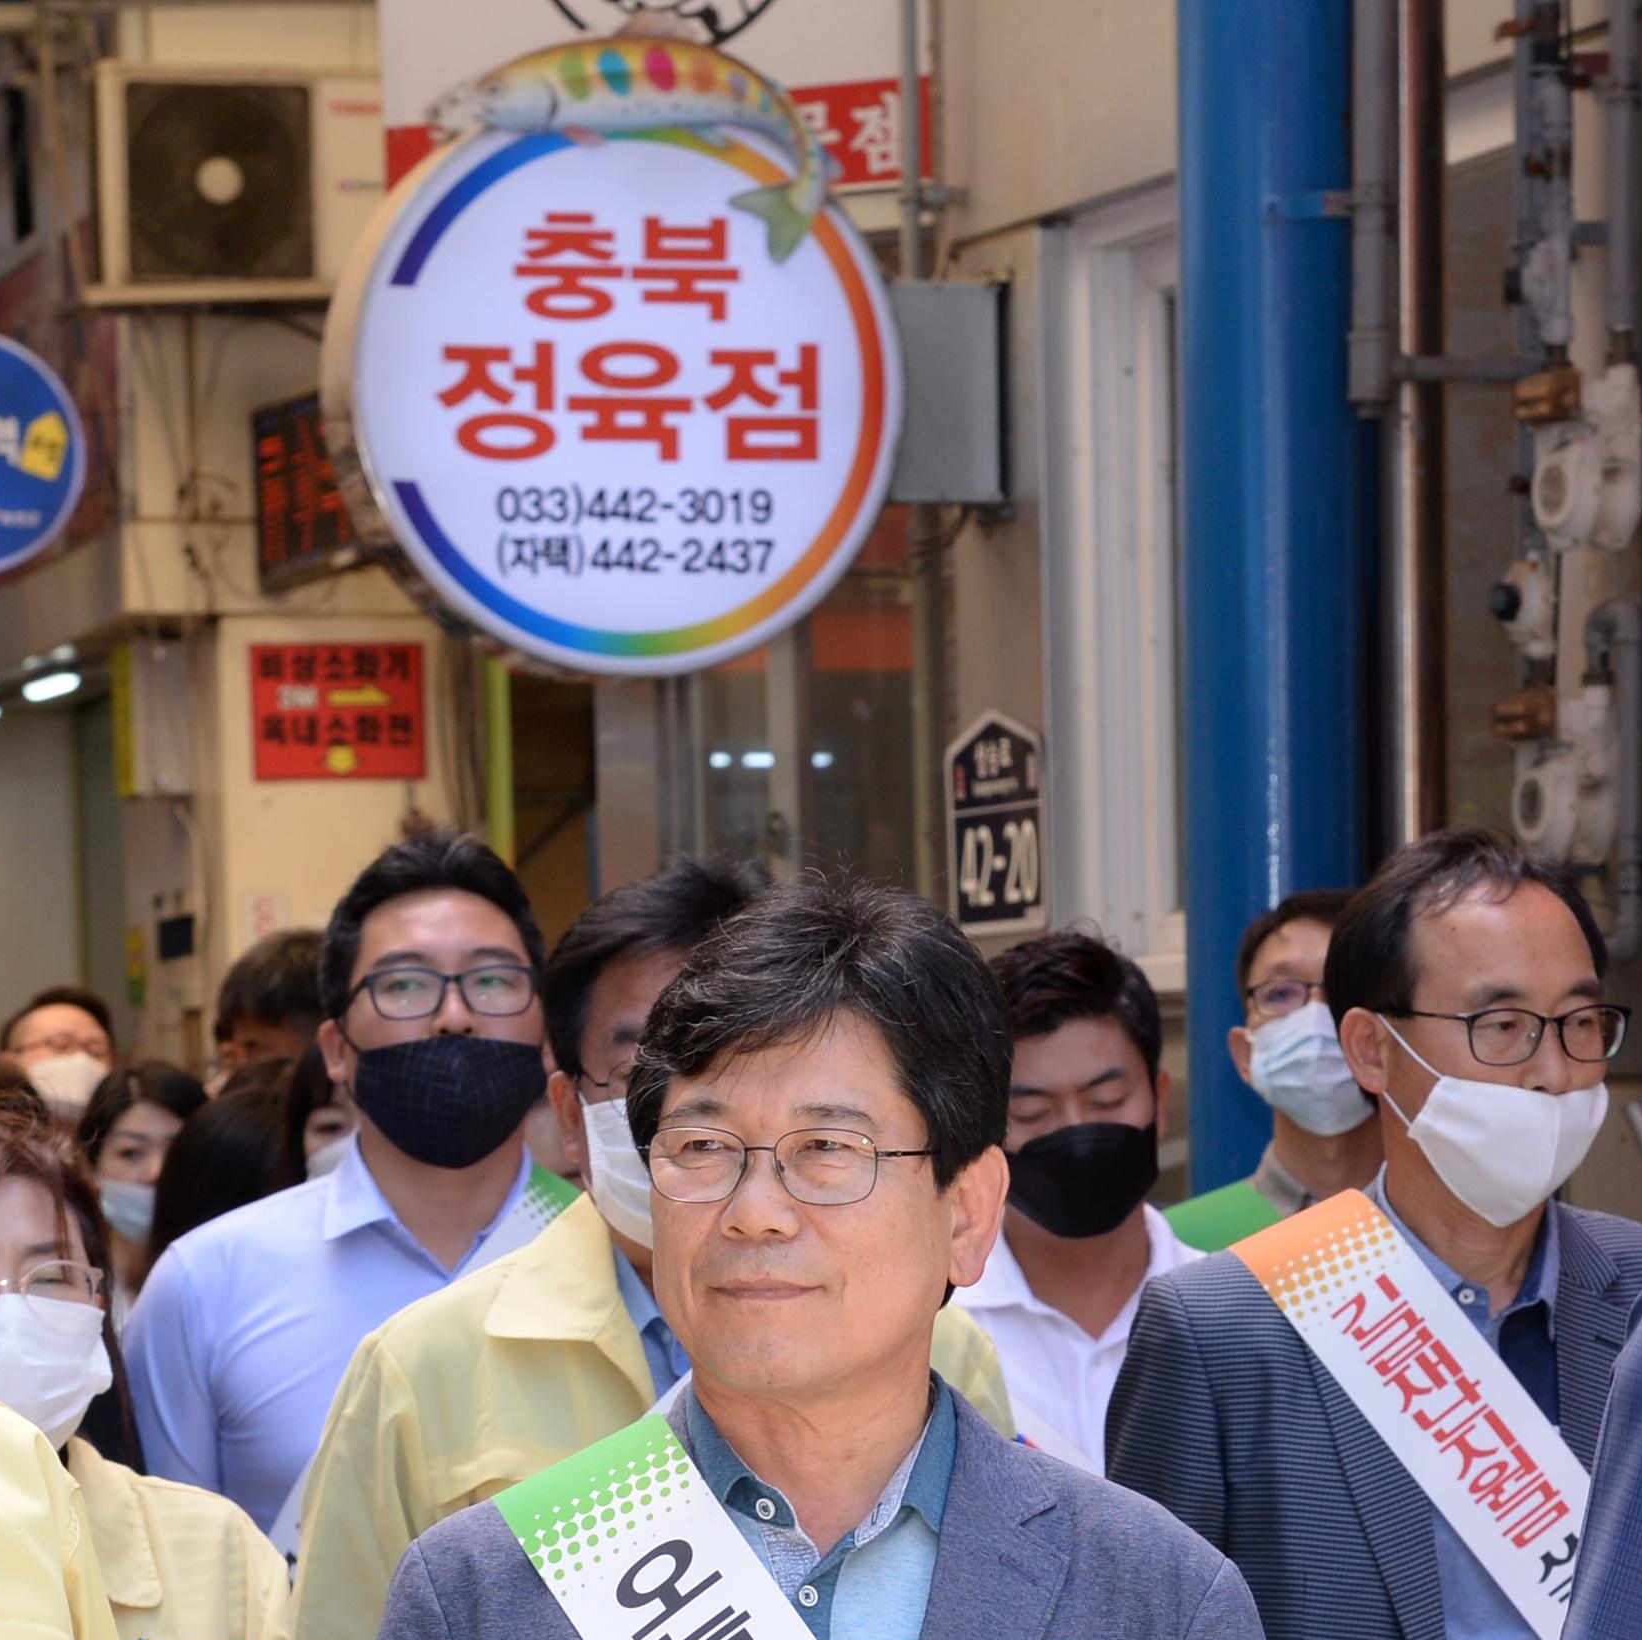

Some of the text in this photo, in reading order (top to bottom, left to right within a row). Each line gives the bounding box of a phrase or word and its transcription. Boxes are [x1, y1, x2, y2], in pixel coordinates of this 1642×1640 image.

[514, 212, 740, 322] 충북
[437, 340, 819, 462] 정육점
[496, 486, 775, 530] 033)442-3019
[496, 534, 775, 579] (자택)442-2437
[1331, 1272, 1571, 1550] 긴급재난지원금
